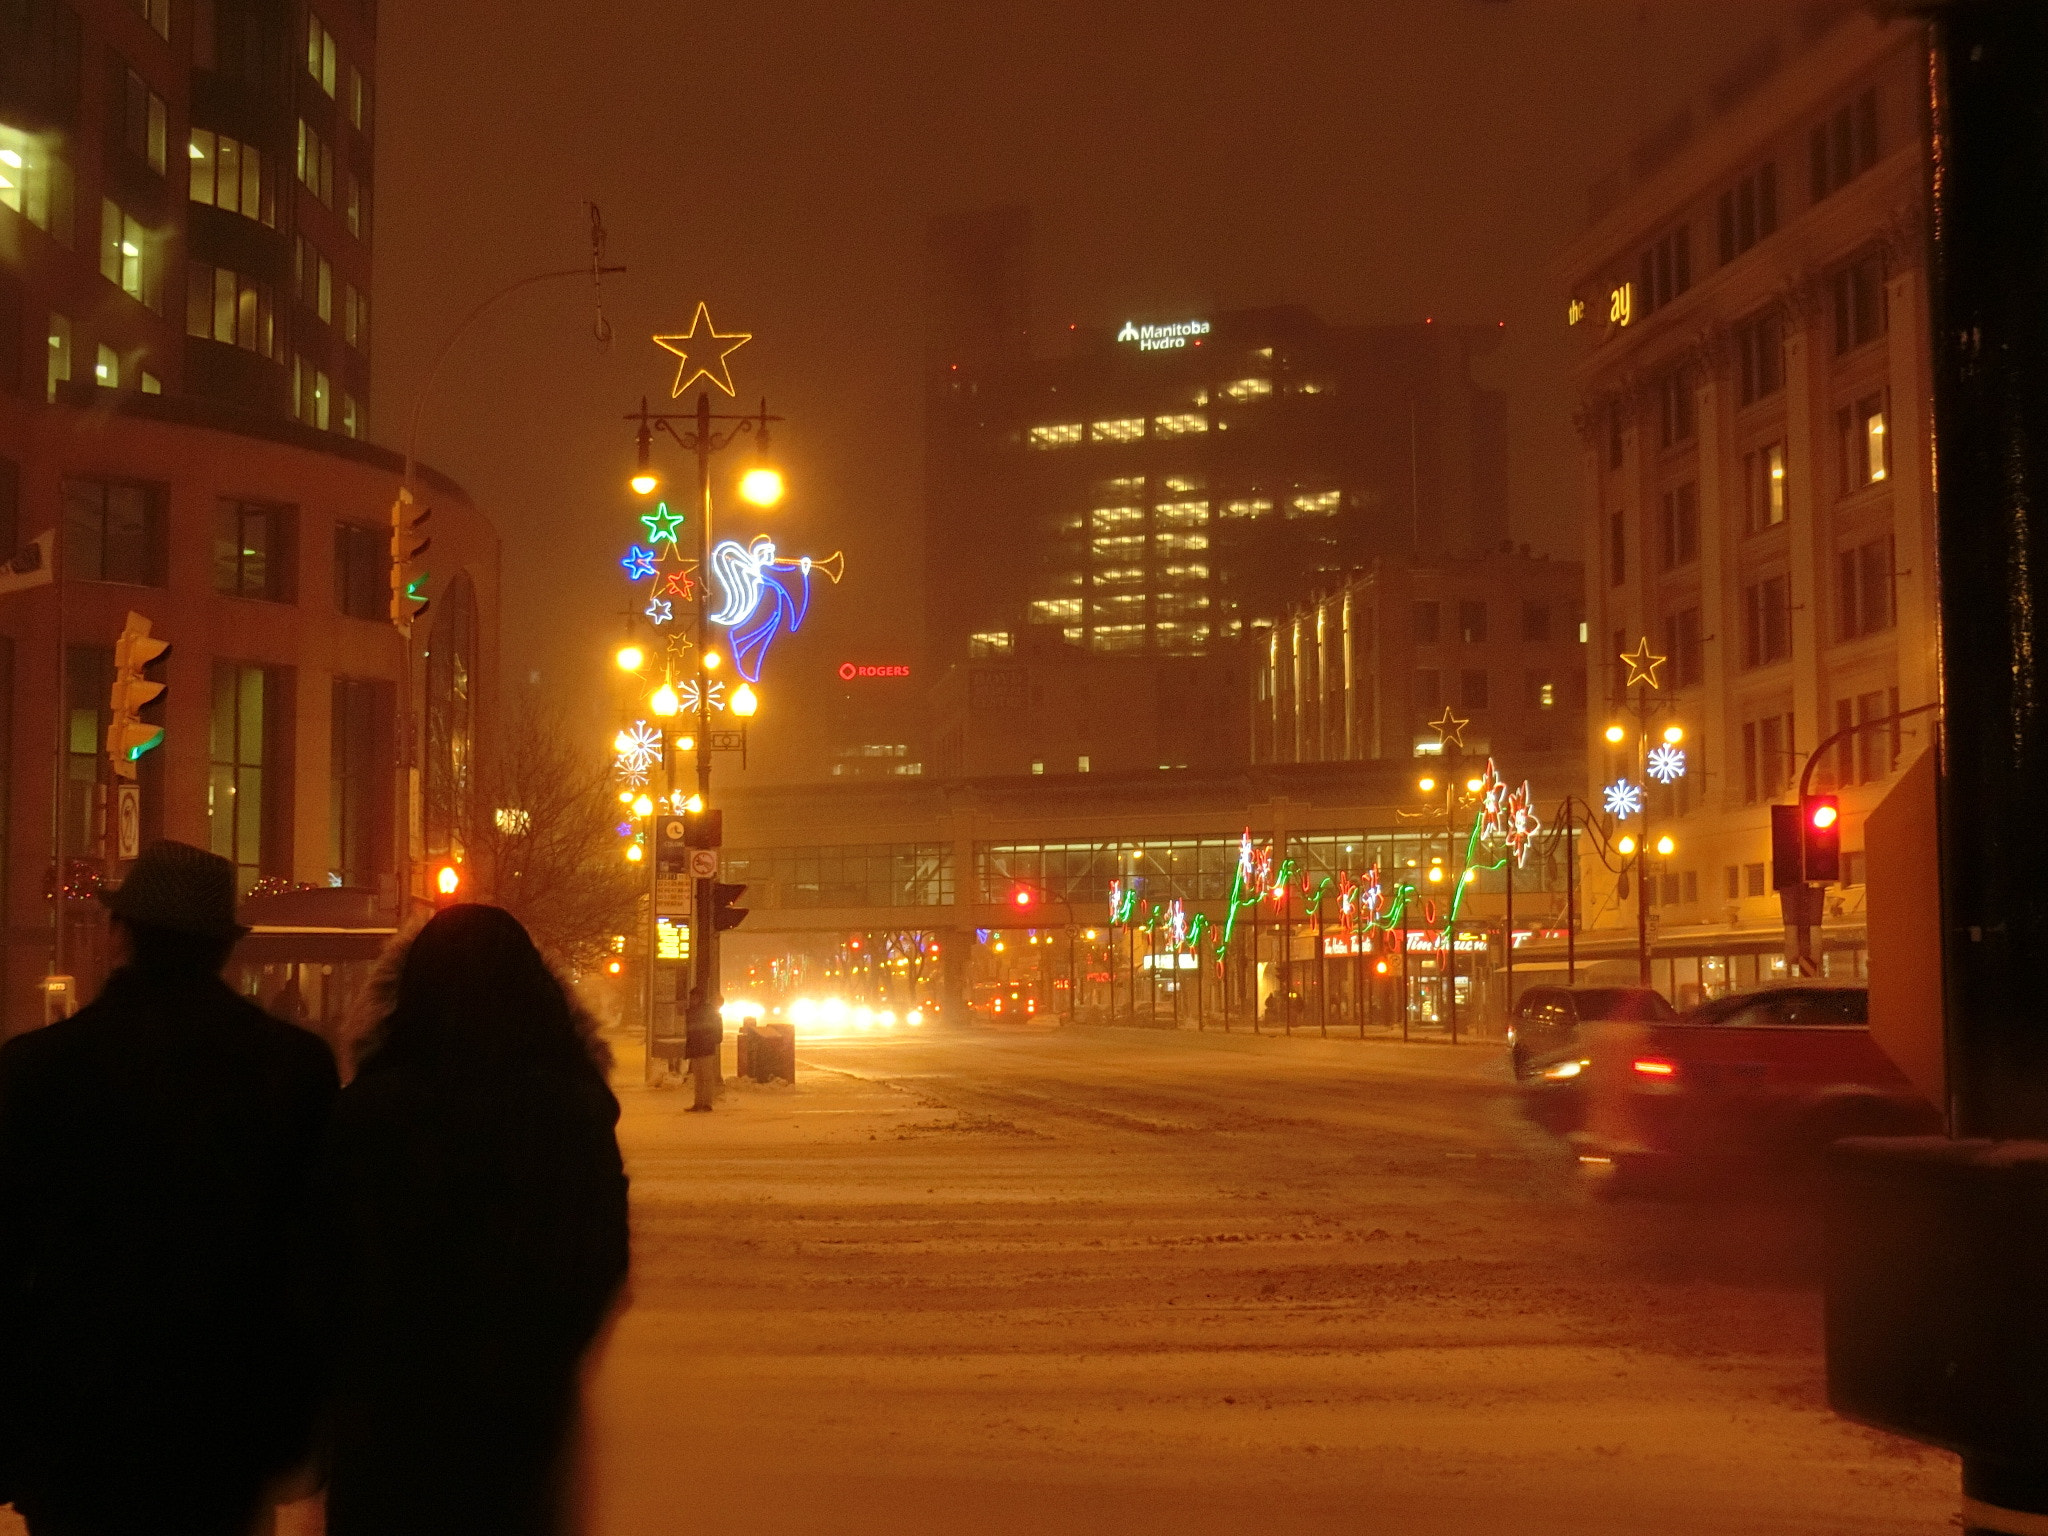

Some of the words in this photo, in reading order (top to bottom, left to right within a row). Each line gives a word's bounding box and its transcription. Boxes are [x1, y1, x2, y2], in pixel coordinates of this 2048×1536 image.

[1140, 320, 1210, 339] Manitoba
[1140, 337, 1185, 351] Hydro
[858, 665, 910, 677] ROGERS
[1406, 932, 1432, 951] Tim
